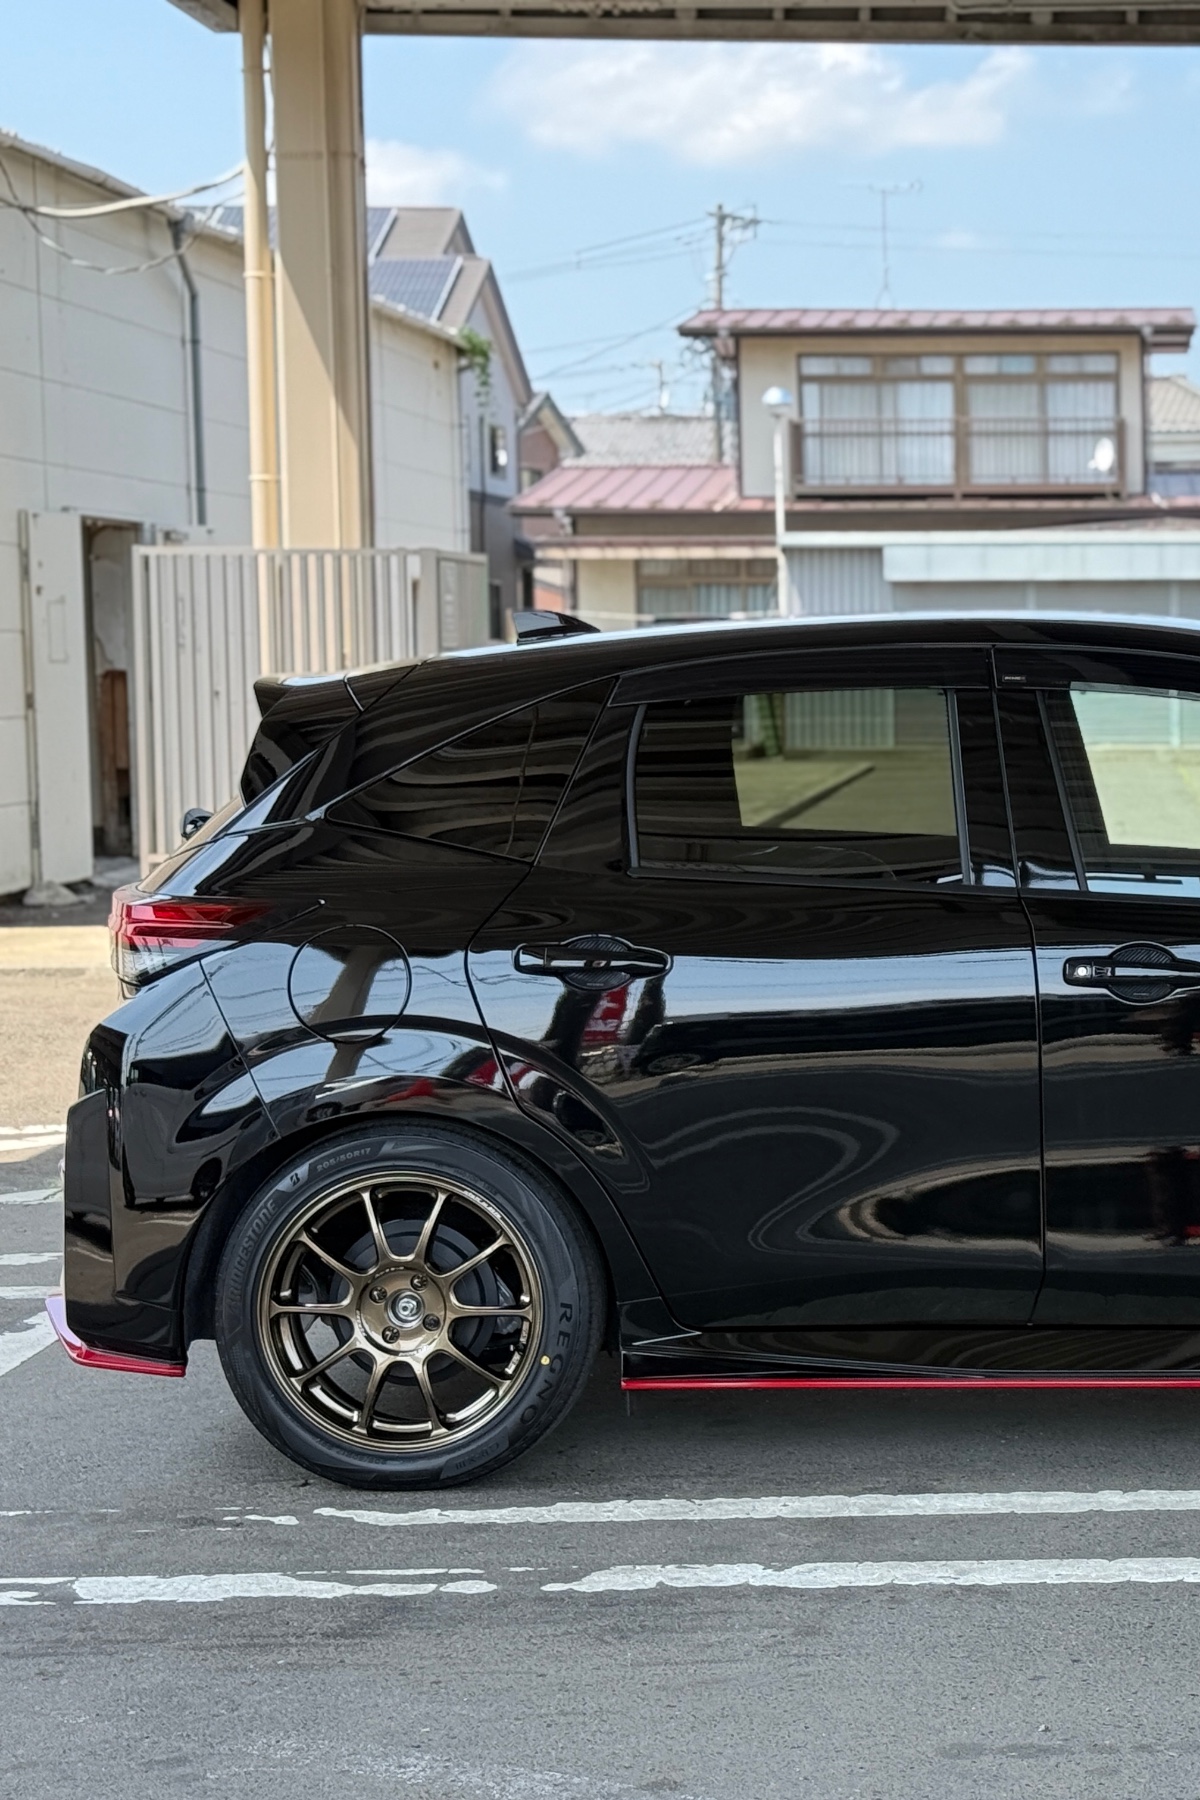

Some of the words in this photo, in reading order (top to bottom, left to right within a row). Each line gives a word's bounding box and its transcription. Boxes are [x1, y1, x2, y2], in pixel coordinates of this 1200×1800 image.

[316, 1146, 372, 1173] 205/50R17
[227, 1199, 279, 1308] BRIDGESTONE
[519, 1302, 573, 1425] REGNO
